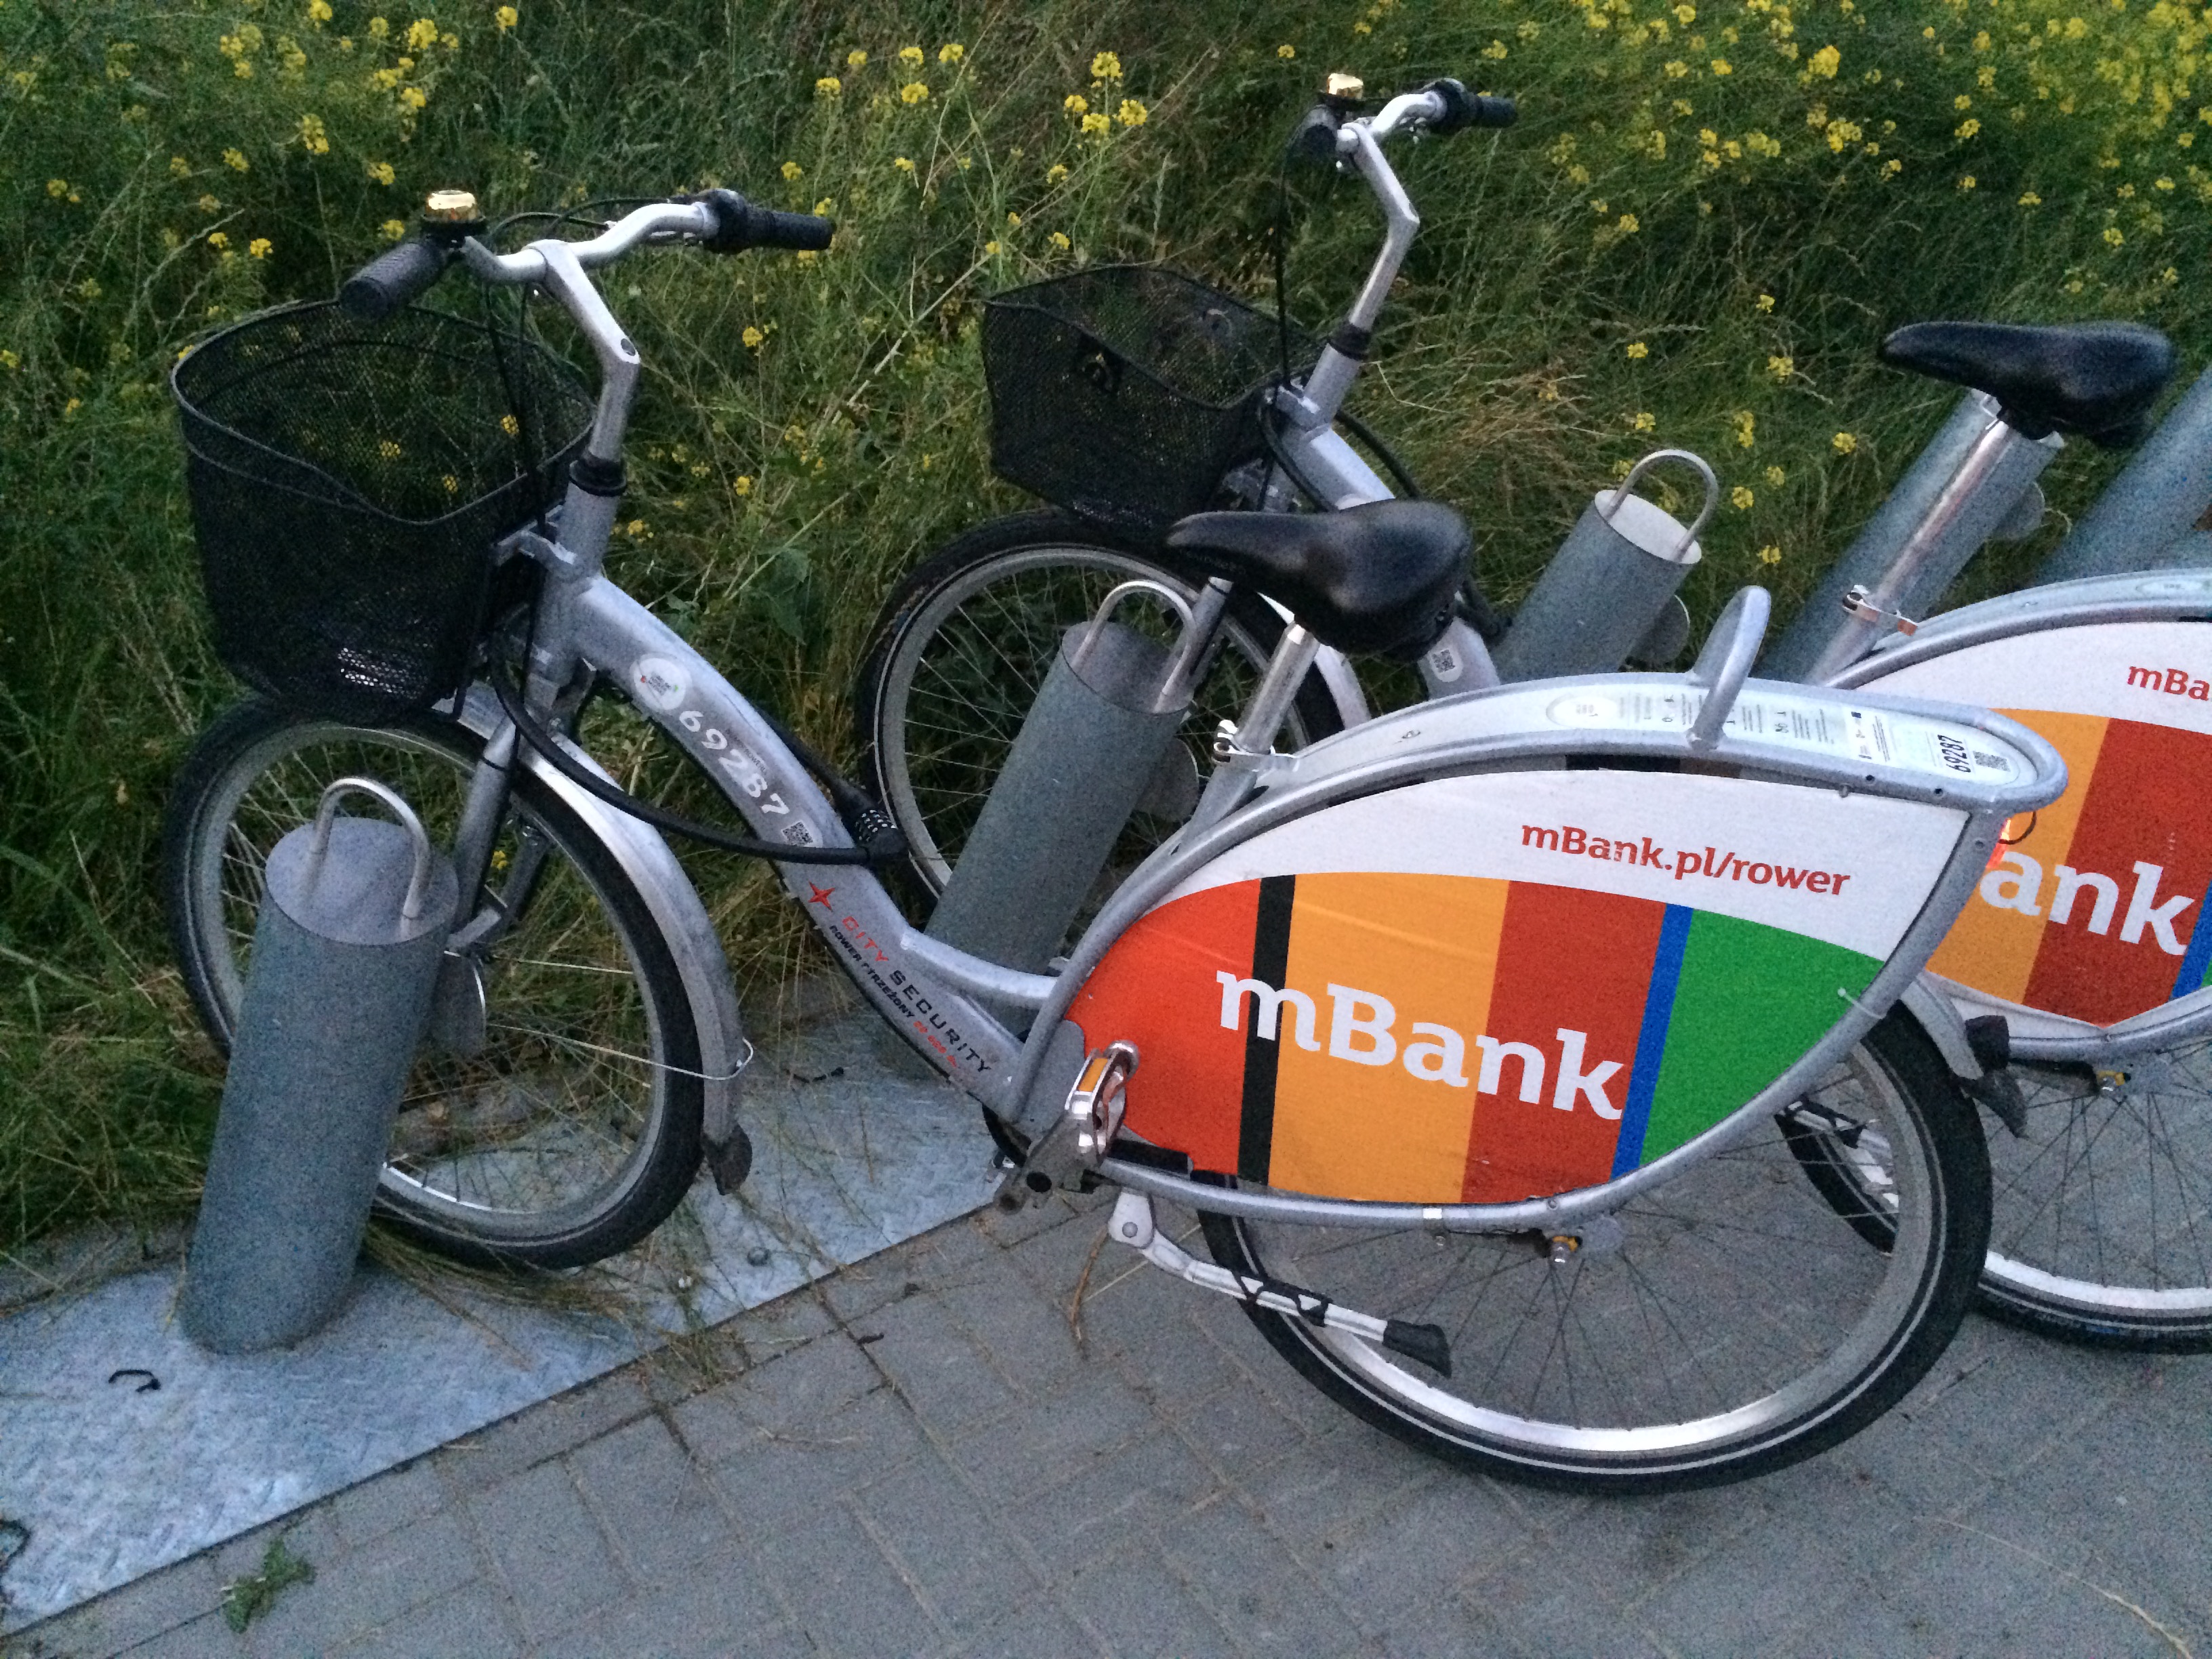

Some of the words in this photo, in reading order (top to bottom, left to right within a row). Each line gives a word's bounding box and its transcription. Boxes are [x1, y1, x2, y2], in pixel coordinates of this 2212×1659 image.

[2128, 665, 2209, 701] mBa
[679, 710, 790, 815] 69287
[1937, 734, 1971, 773] 69287
[1521, 825, 1850, 897] mBank.pl/rower
[829, 924, 863, 962] ROWER
[842, 916, 889, 962] CITY
[888, 969, 992, 1073] SECURITY
[1215, 970, 1624, 1120] mBank
